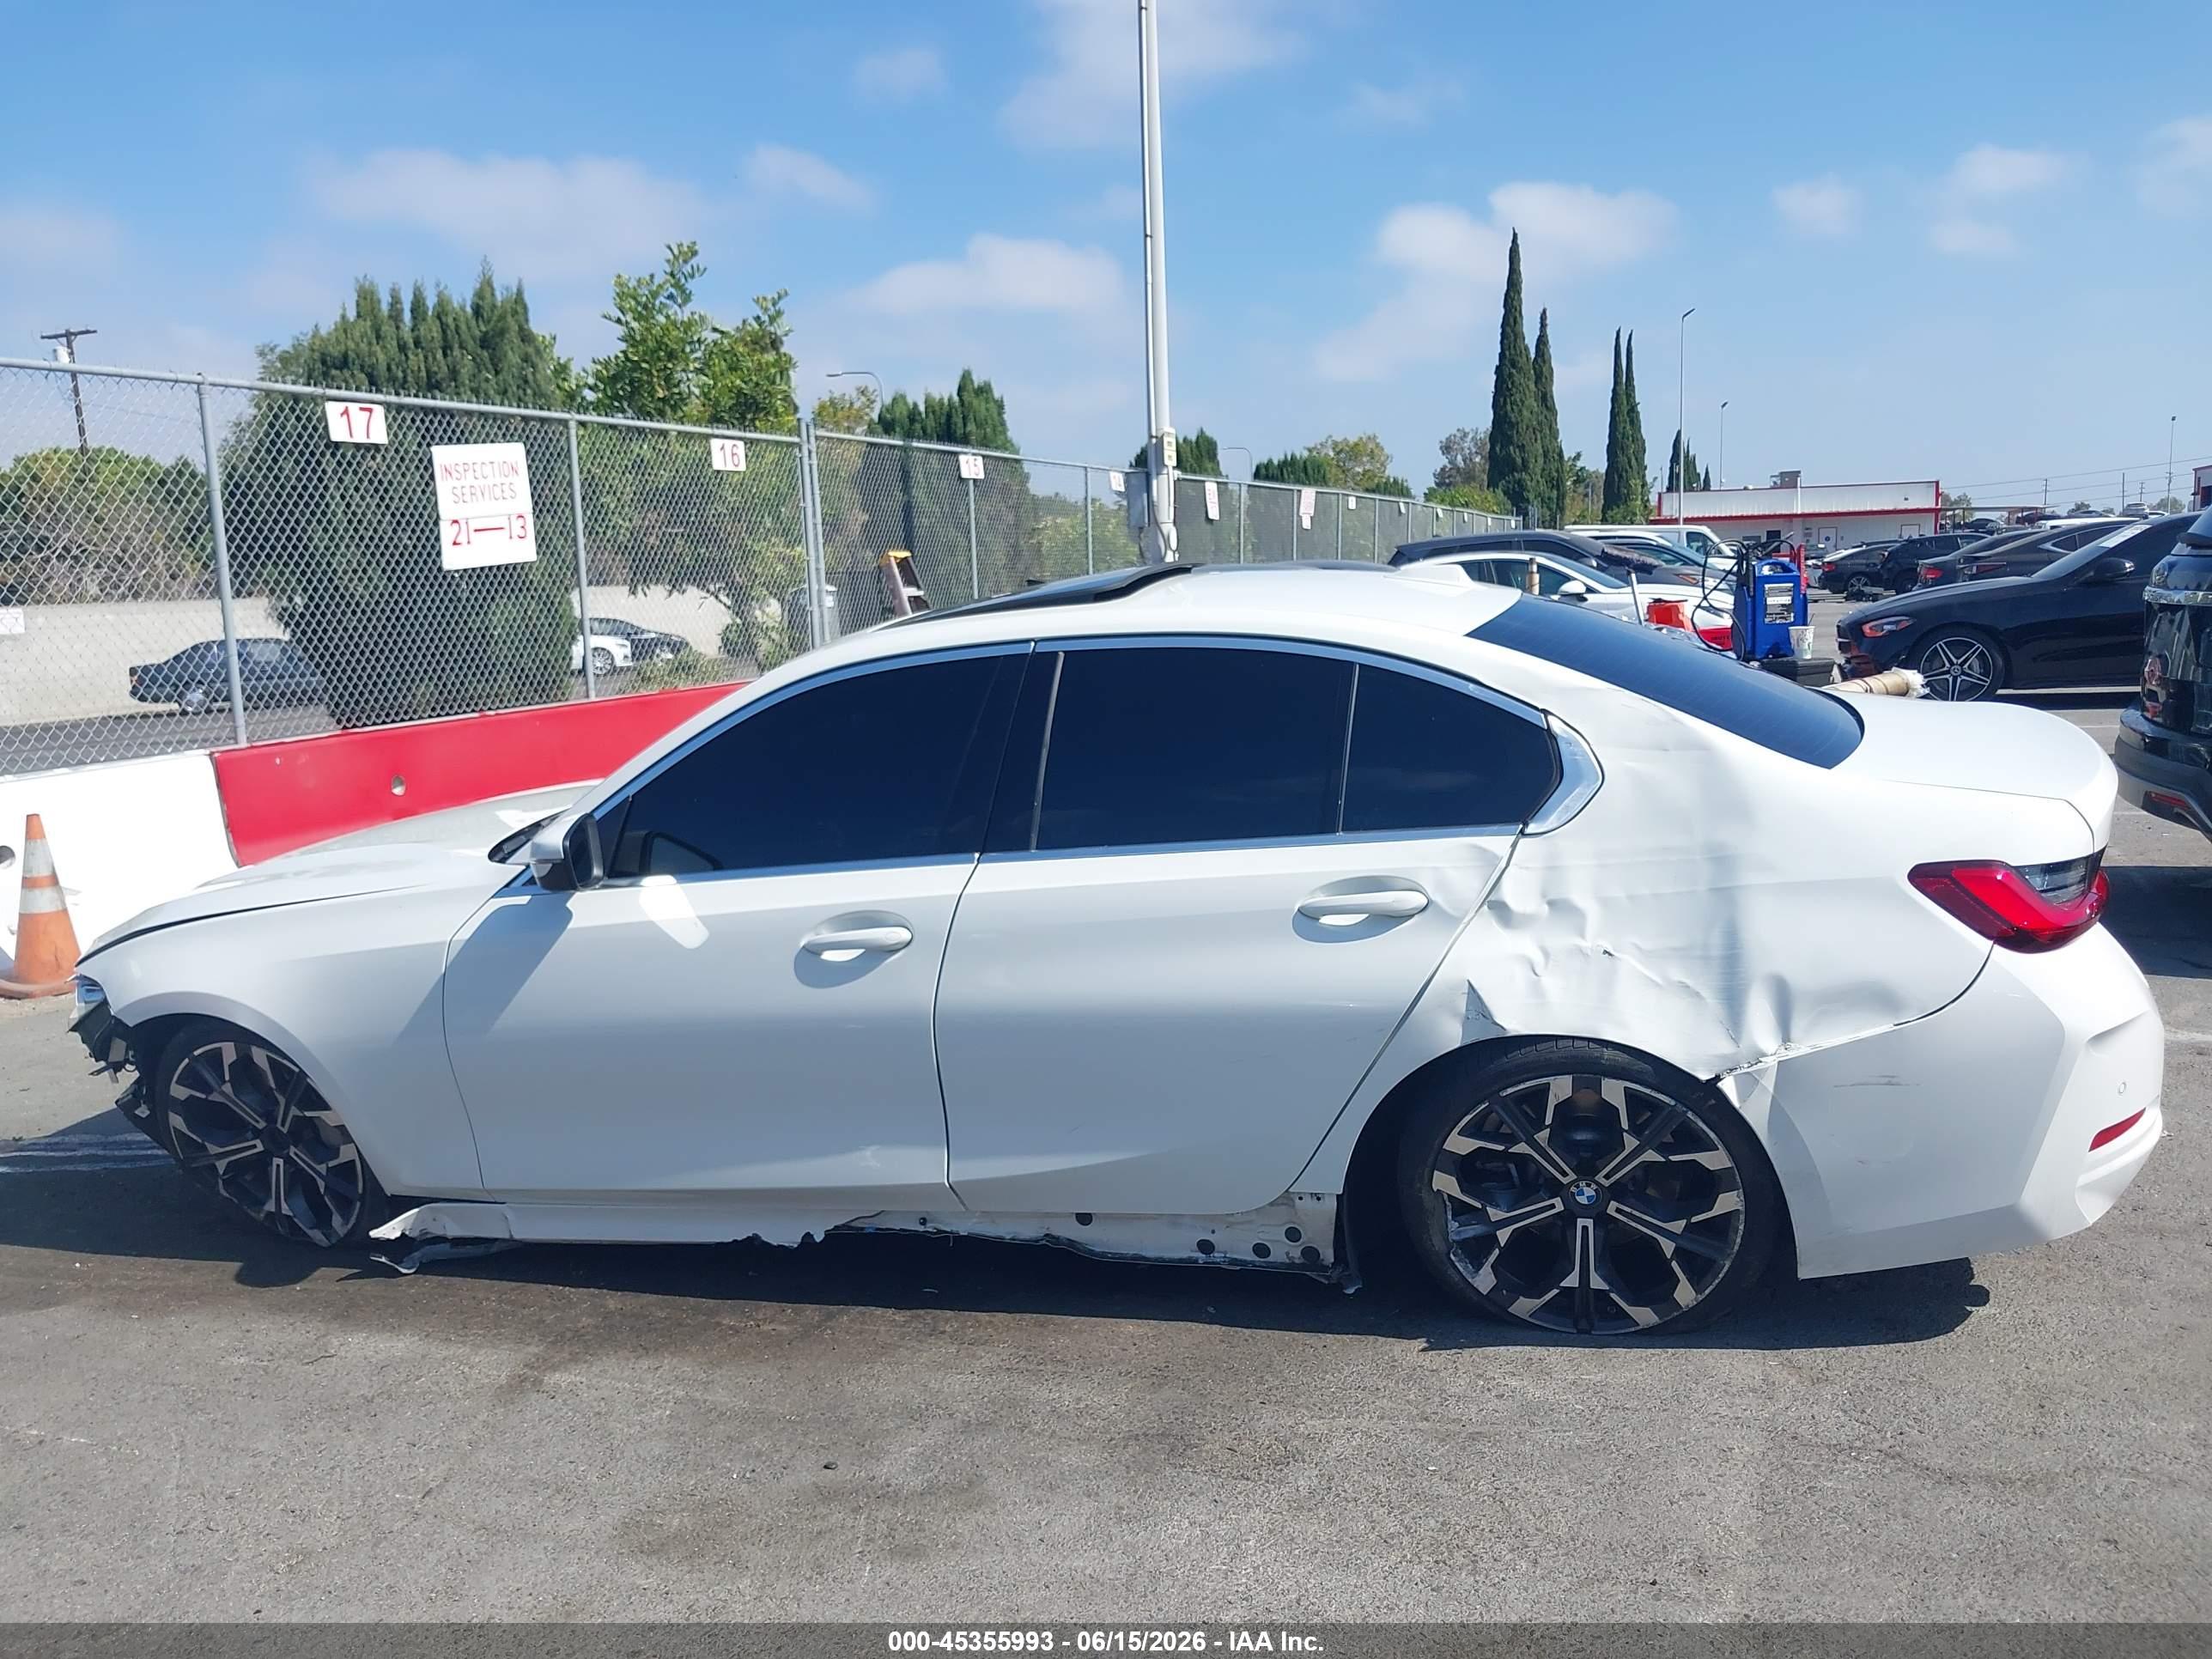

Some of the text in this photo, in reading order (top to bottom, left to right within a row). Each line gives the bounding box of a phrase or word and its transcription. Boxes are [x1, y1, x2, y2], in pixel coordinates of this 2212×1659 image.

[340, 405, 374, 439] 17
[720, 442, 740, 468] 16
[439, 460, 520, 482] INSPECTION
[965, 458, 981, 477] 15
[452, 483, 517, 505] SERVICES
